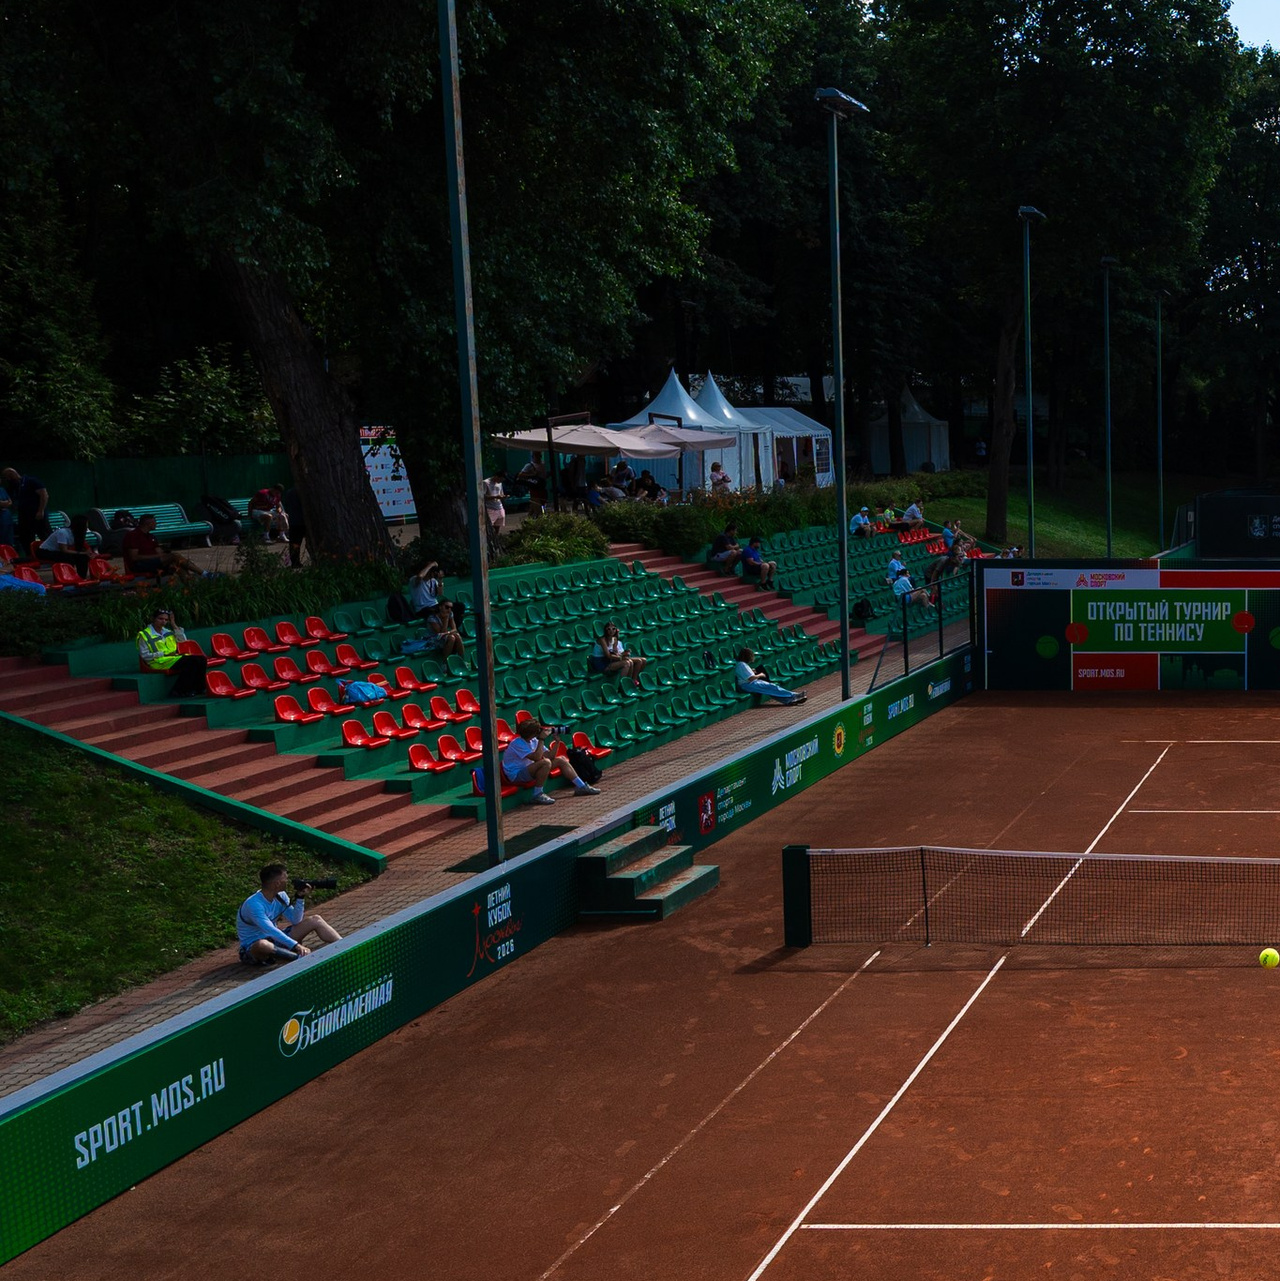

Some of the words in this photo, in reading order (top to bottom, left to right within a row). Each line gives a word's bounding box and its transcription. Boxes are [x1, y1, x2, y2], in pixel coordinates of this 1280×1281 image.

[1087, 599, 1169, 620] ОТКРЫТЫЙ
[1174, 602, 1231, 620] ТУРНИР
[1114, 623, 1134, 641] ПО
[1138, 623, 1205, 642] ТЕННИСУ
[1078, 668, 1125, 679] SPORT.MOS.RU
[785, 734, 819, 768] МОСКОВСКИЙ
[785, 764, 802, 788] СПОРТ
[487, 882, 511, 909] ЛЕТНИЙ
[487, 900, 512, 928] КУБОК
[497, 939, 515, 960] 2026
[278, 979, 393, 1057] БЕЛОКАМЕННАЯ
[73, 1057, 227, 1170] SPORT.MOS.RU
